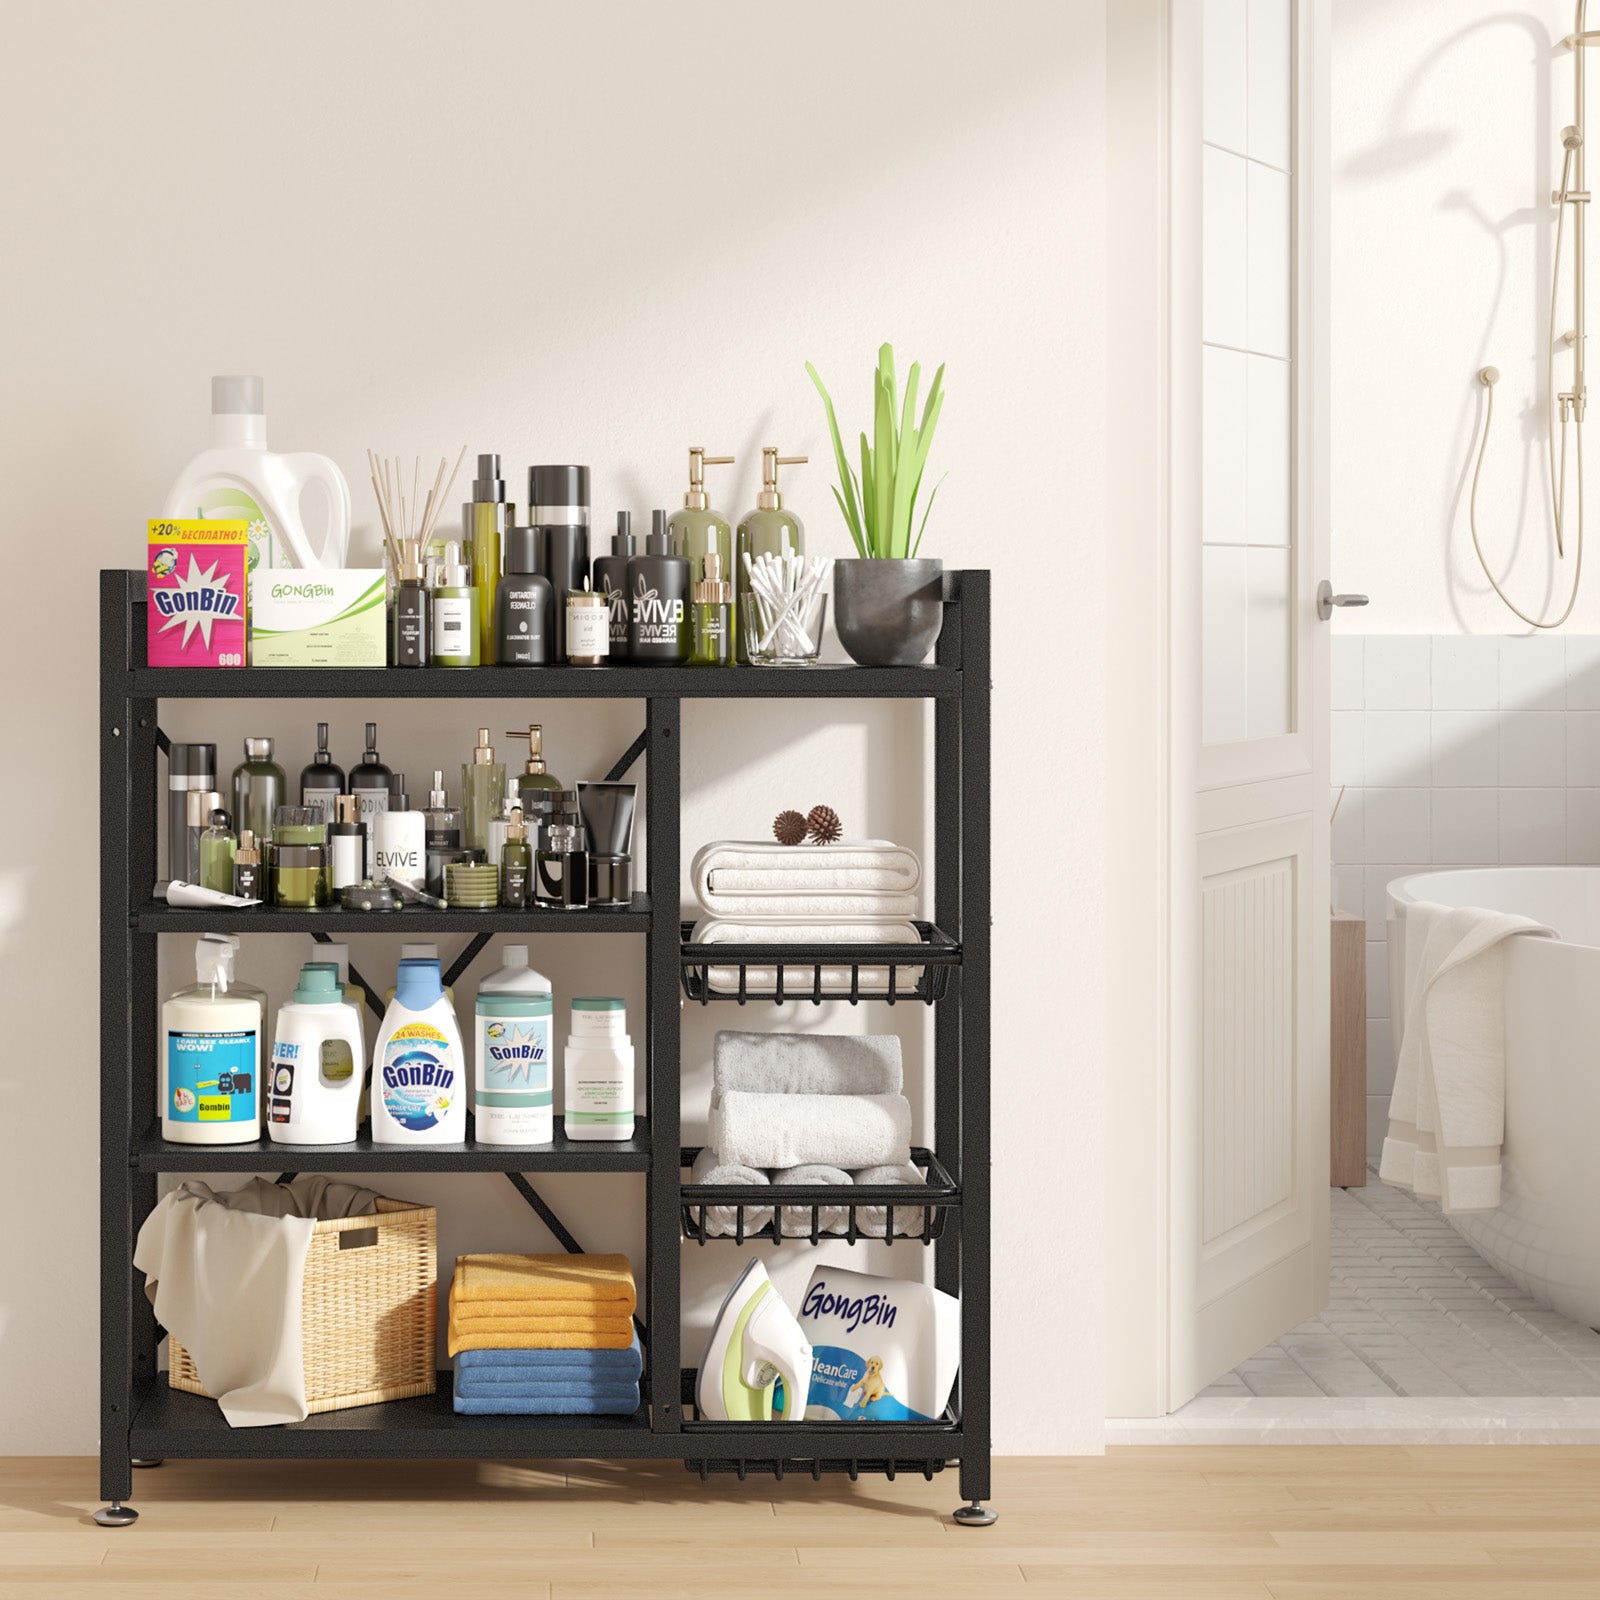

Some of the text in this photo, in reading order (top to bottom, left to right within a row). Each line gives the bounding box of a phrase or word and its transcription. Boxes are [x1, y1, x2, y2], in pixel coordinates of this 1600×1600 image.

[151, 523, 244, 541] +20% БЕСПЛАТНО!
[155, 587, 238, 616] GonBin
[218, 653, 241, 667] 600
[361, 799, 384, 813] ODIN
[376, 851, 417, 867] ELVIVE
[396, 1029, 441, 1040] 24 WASHES
[176, 1043, 214, 1052] WOW!
[489, 1044, 544, 1060] GonBin
[382, 1063, 454, 1089] GonBin
[801, 1281, 898, 1334] GongBin
